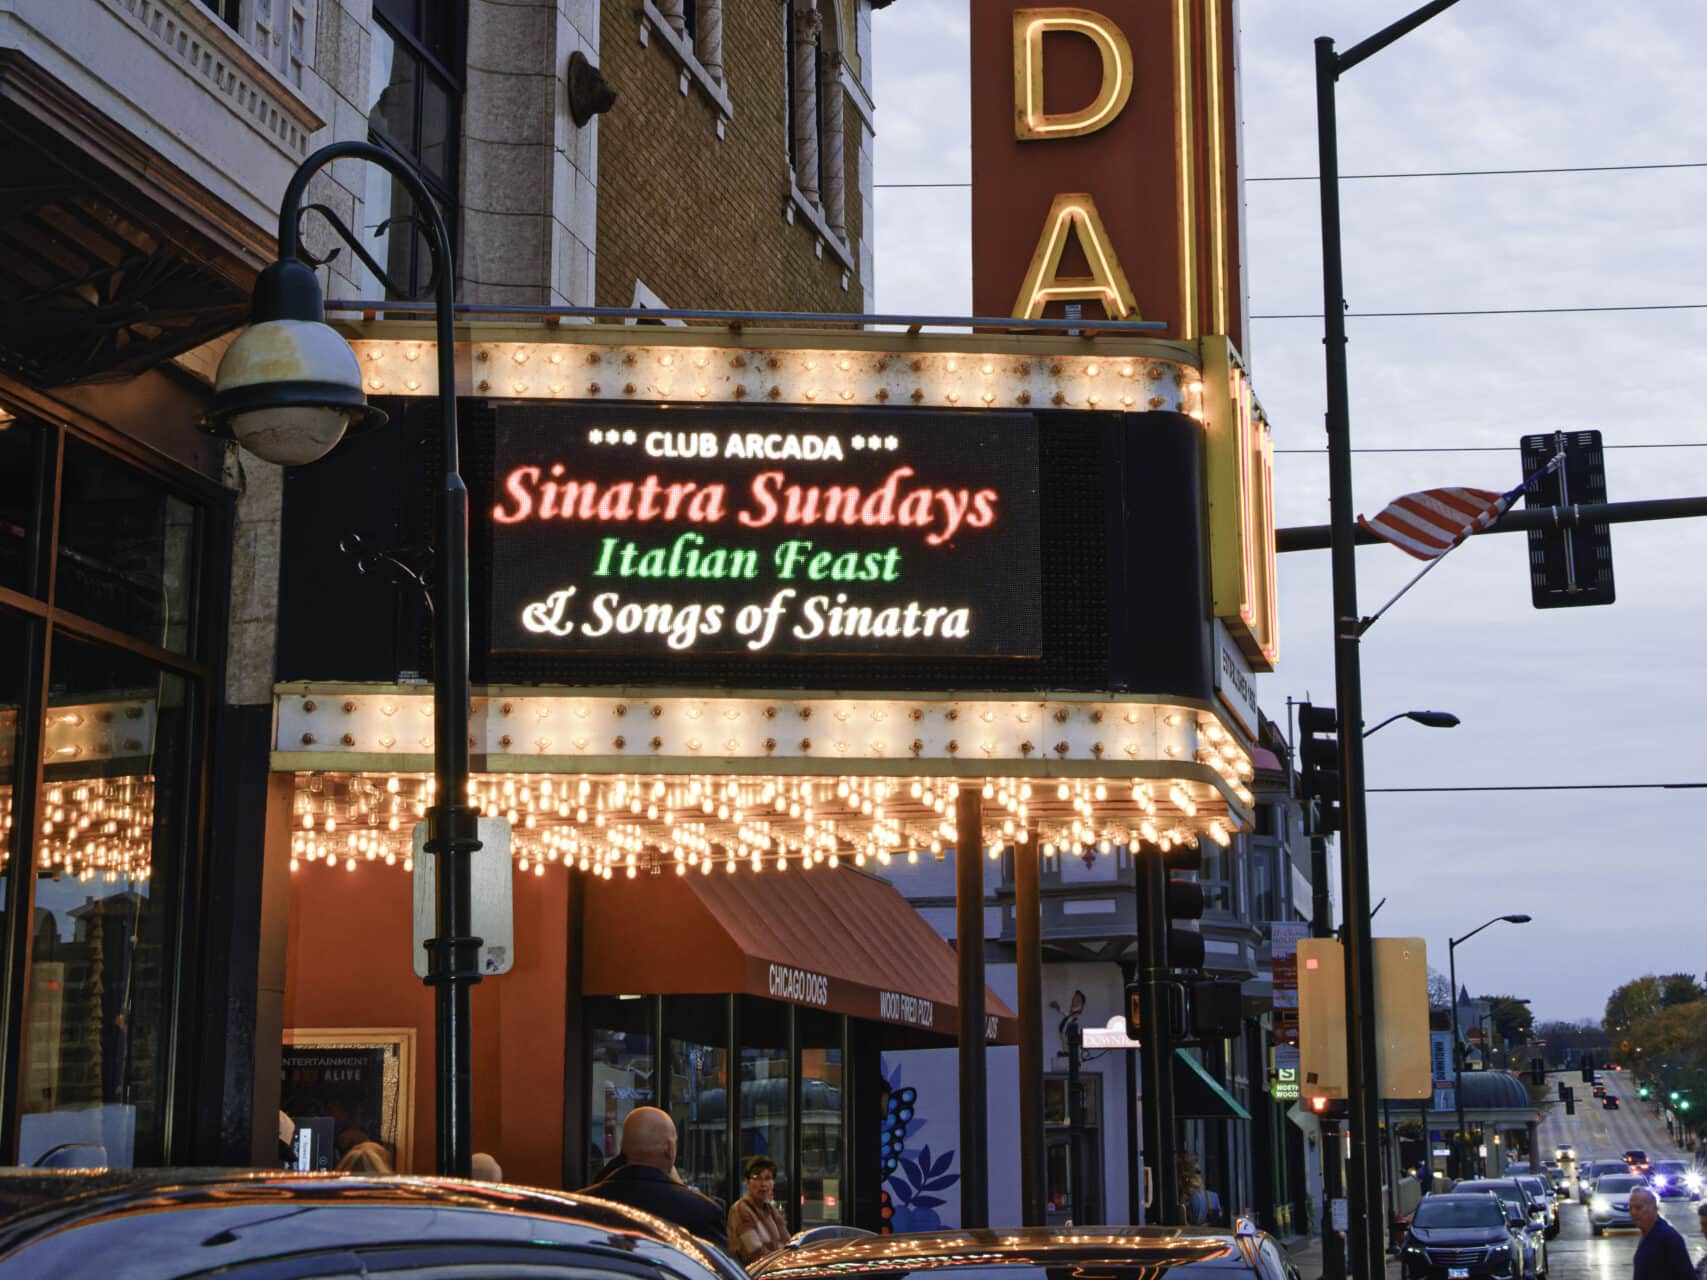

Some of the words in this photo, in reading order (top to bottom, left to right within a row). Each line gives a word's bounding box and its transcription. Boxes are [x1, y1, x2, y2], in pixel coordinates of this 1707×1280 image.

[645, 431, 719, 459] CLUB
[725, 434, 844, 462] ARCADA
[493, 464, 728, 523] Sinatra
[739, 466, 998, 544] Sundays
[594, 534, 759, 579] Italian
[775, 540, 904, 581] Feast
[523, 587, 576, 637] &
[582, 592, 724, 650] Songs
[735, 589, 796, 650] of
[793, 593, 970, 640] Sinatra
[769, 963, 806, 1000] CHICAGO
[806, 973, 828, 1006] DOGS
[880, 991, 900, 1019] WOOD
[900, 994, 917, 1022] FIRED
[917, 999, 934, 1026] PIZZA
[282, 1056, 369, 1067] NTERTAINMENT
[324, 1069, 361, 1080] ALIVE
